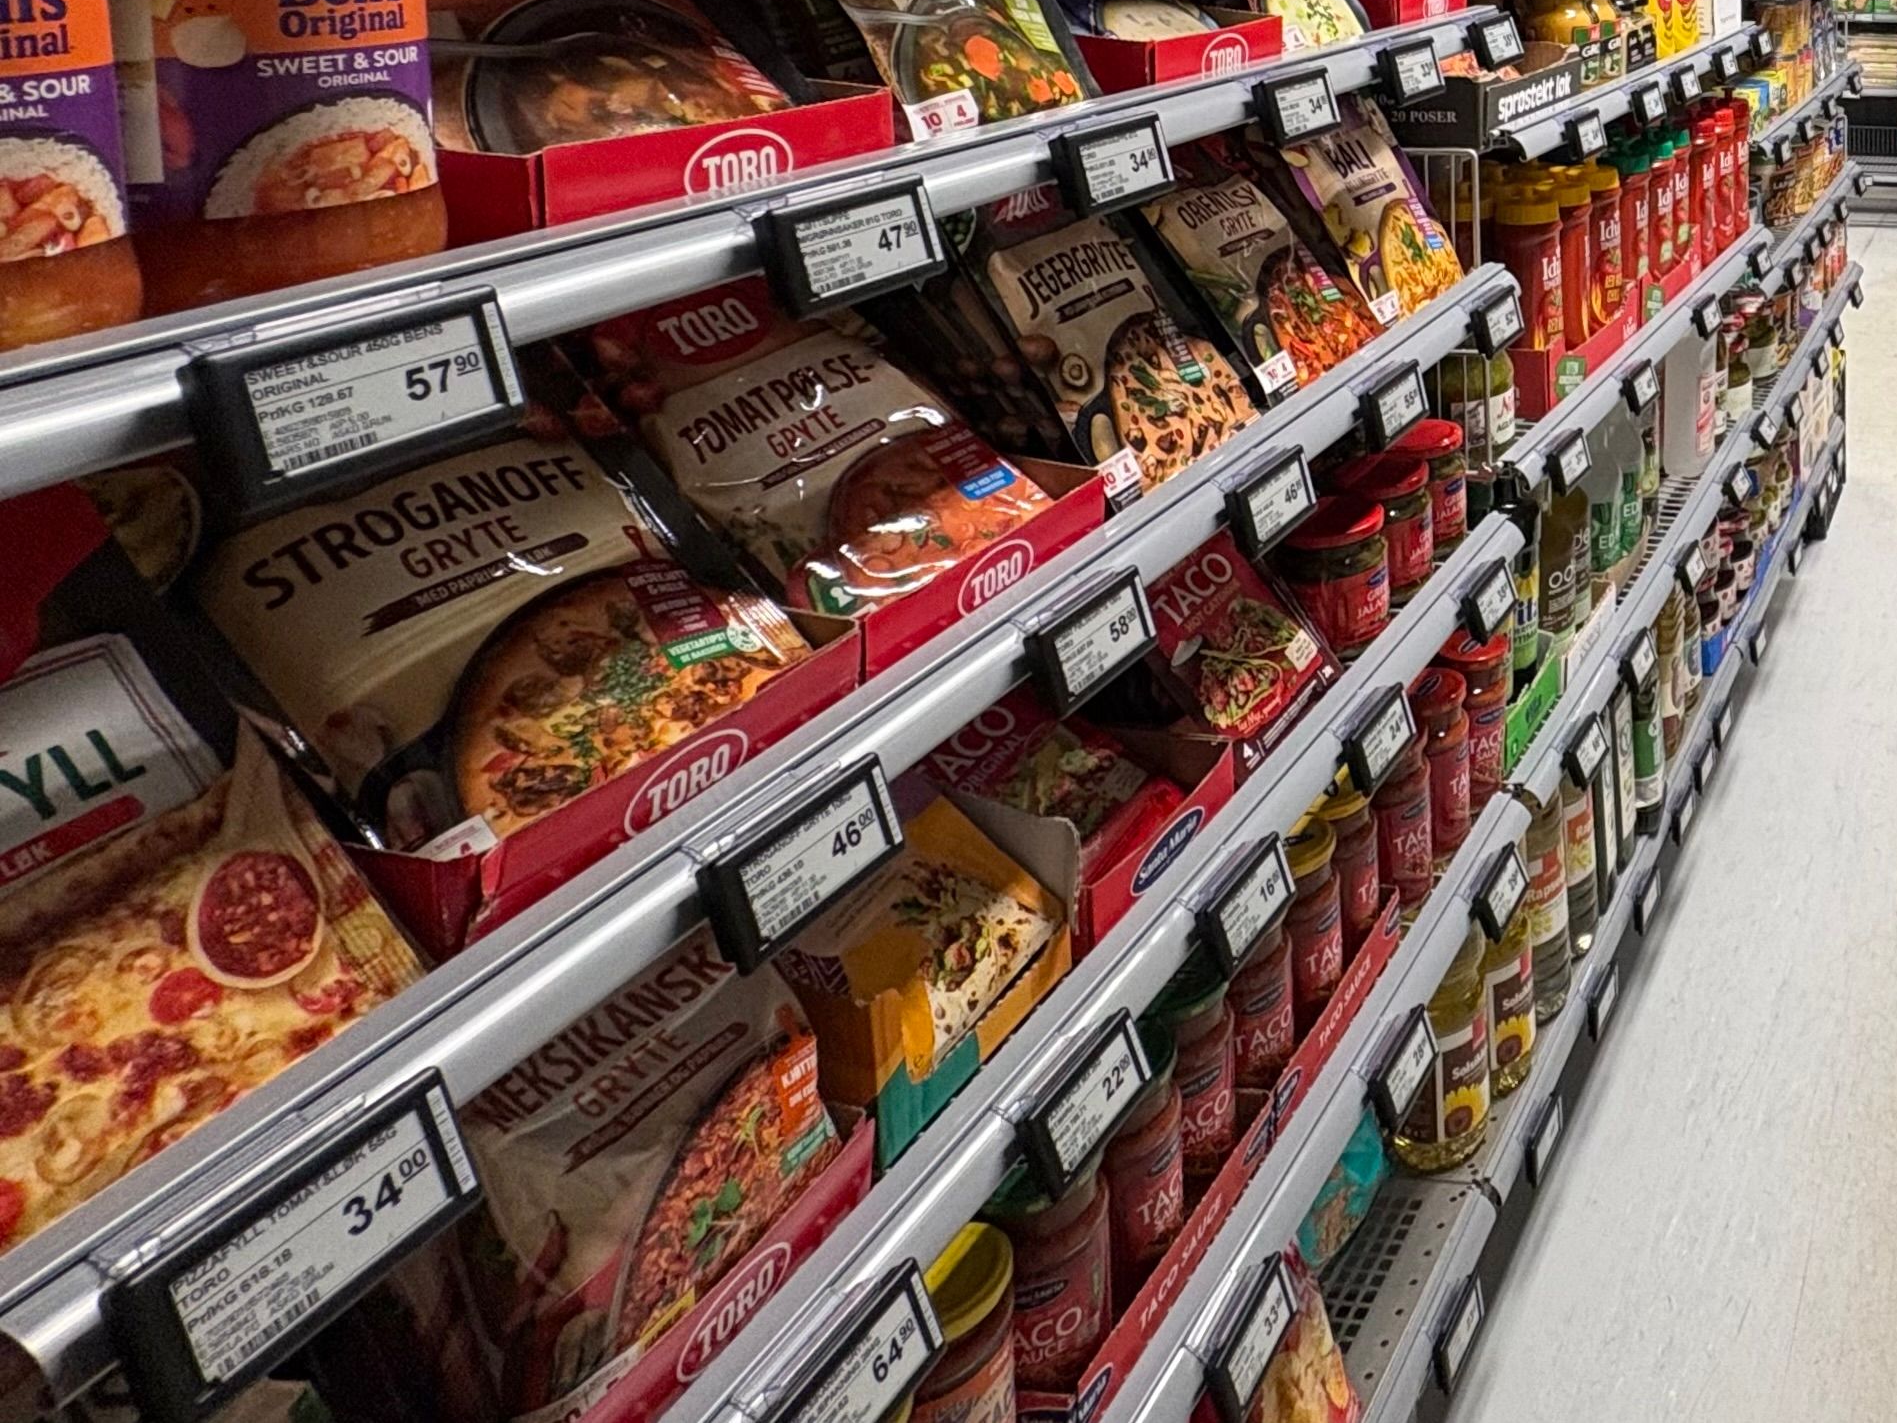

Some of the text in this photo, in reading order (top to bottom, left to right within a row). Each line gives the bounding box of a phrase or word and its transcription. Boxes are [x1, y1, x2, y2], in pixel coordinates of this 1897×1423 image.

[278, 6, 407, 42] Original
[256, 44, 419, 78] SWEET & SOUR
[317, 70, 392, 89] ORIGINAL
[23, 74, 91, 103] SOUR
[1408, 109, 1458, 124] POSER
[702, 144, 778, 191] TORO
[1017, 239, 1137, 321] JEGERGRYTE
[403, 323, 443, 343] BENS
[657, 298, 758, 357] TORO
[252, 374, 330, 402] ORIGINAL
[766, 404, 846, 459] GRYTE
[243, 455, 587, 611] STROGANOFF
[401, 515, 529, 580] GRYTE
[972, 548, 1023, 605] TORO
[1152, 552, 1233, 627] TACO
[647, 742, 732, 824] TORO
[478, 942, 736, 1135] MEKSIKANSK
[1235, 1004, 1292, 1056] TACO
[573, 1026, 689, 1121] GRYTE
[1179, 1087, 1231, 1135] ACO
[180, 1266, 231, 1310] TORO
[698, 1260, 776, 1358] TORO
